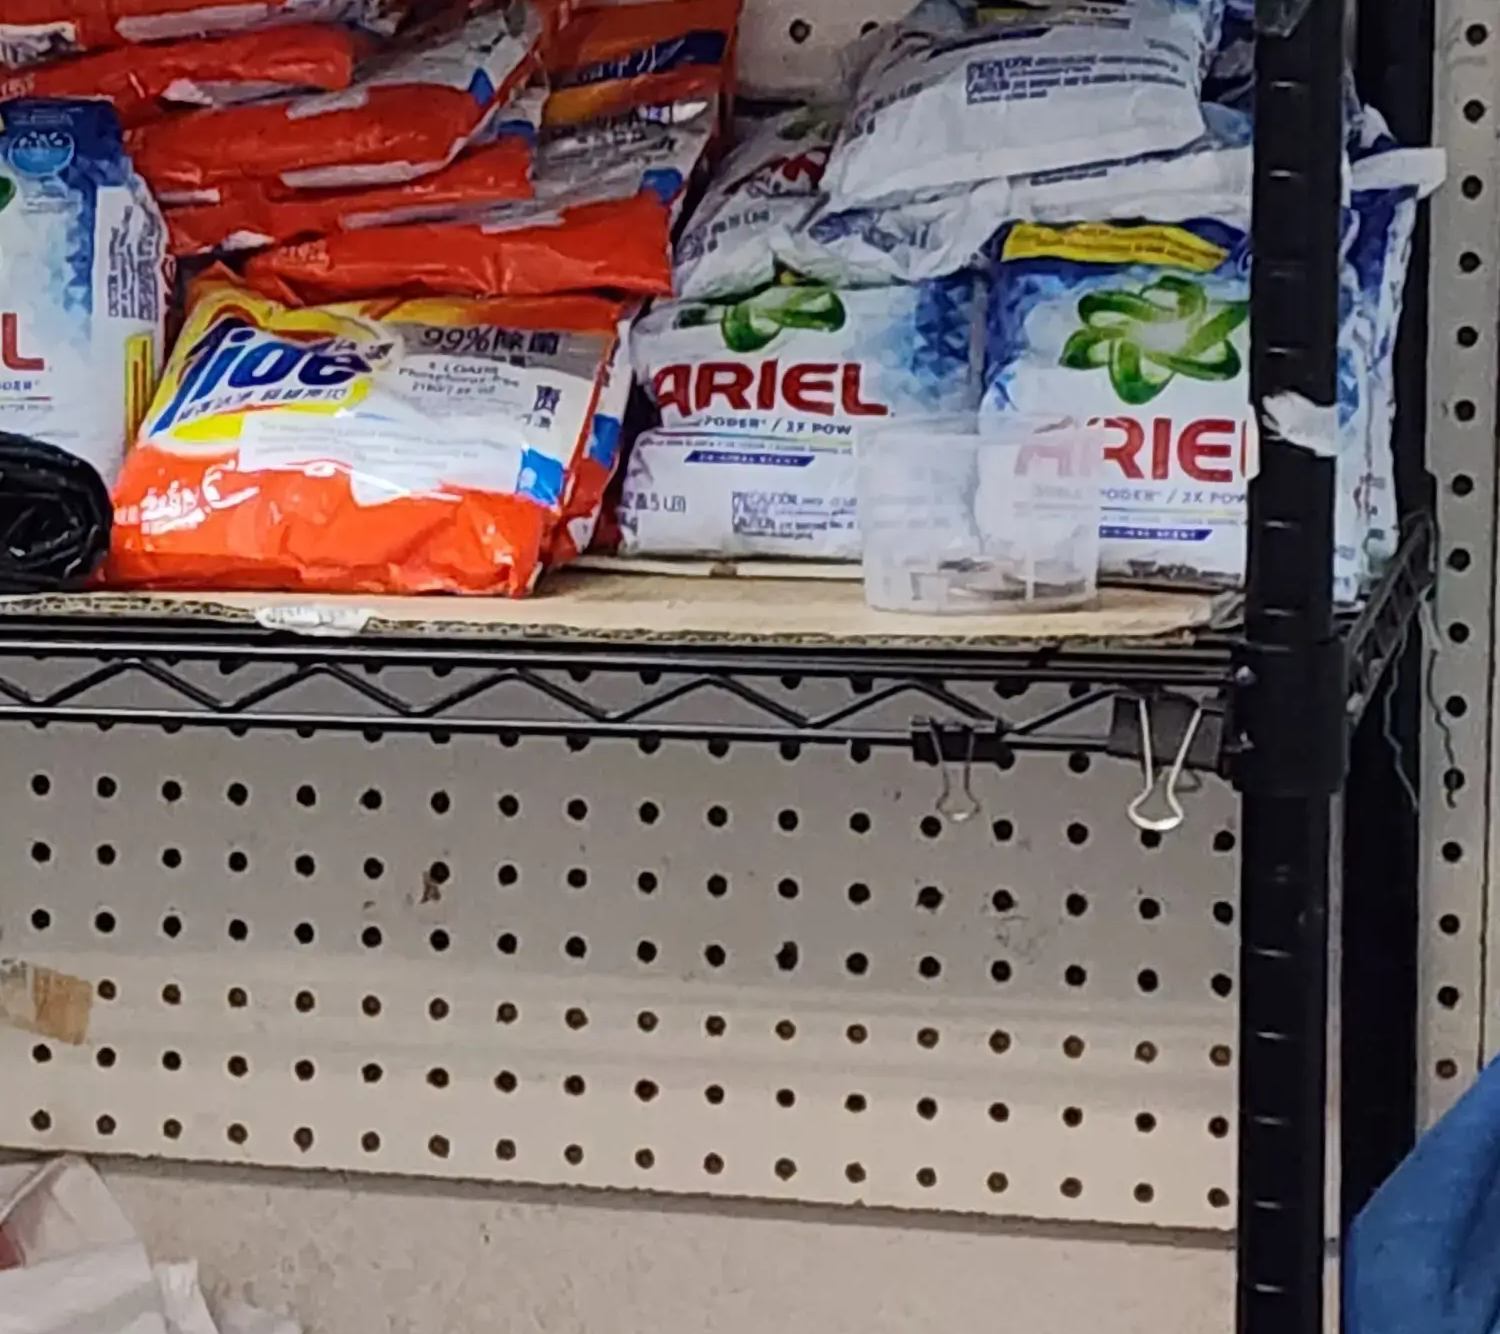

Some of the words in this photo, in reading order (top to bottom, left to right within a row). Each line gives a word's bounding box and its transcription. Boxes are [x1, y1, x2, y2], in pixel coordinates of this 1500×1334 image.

[653, 358, 889, 420] ARIEL
[811, 423, 853, 436] POW
[1014, 414, 1248, 483] ARIE
